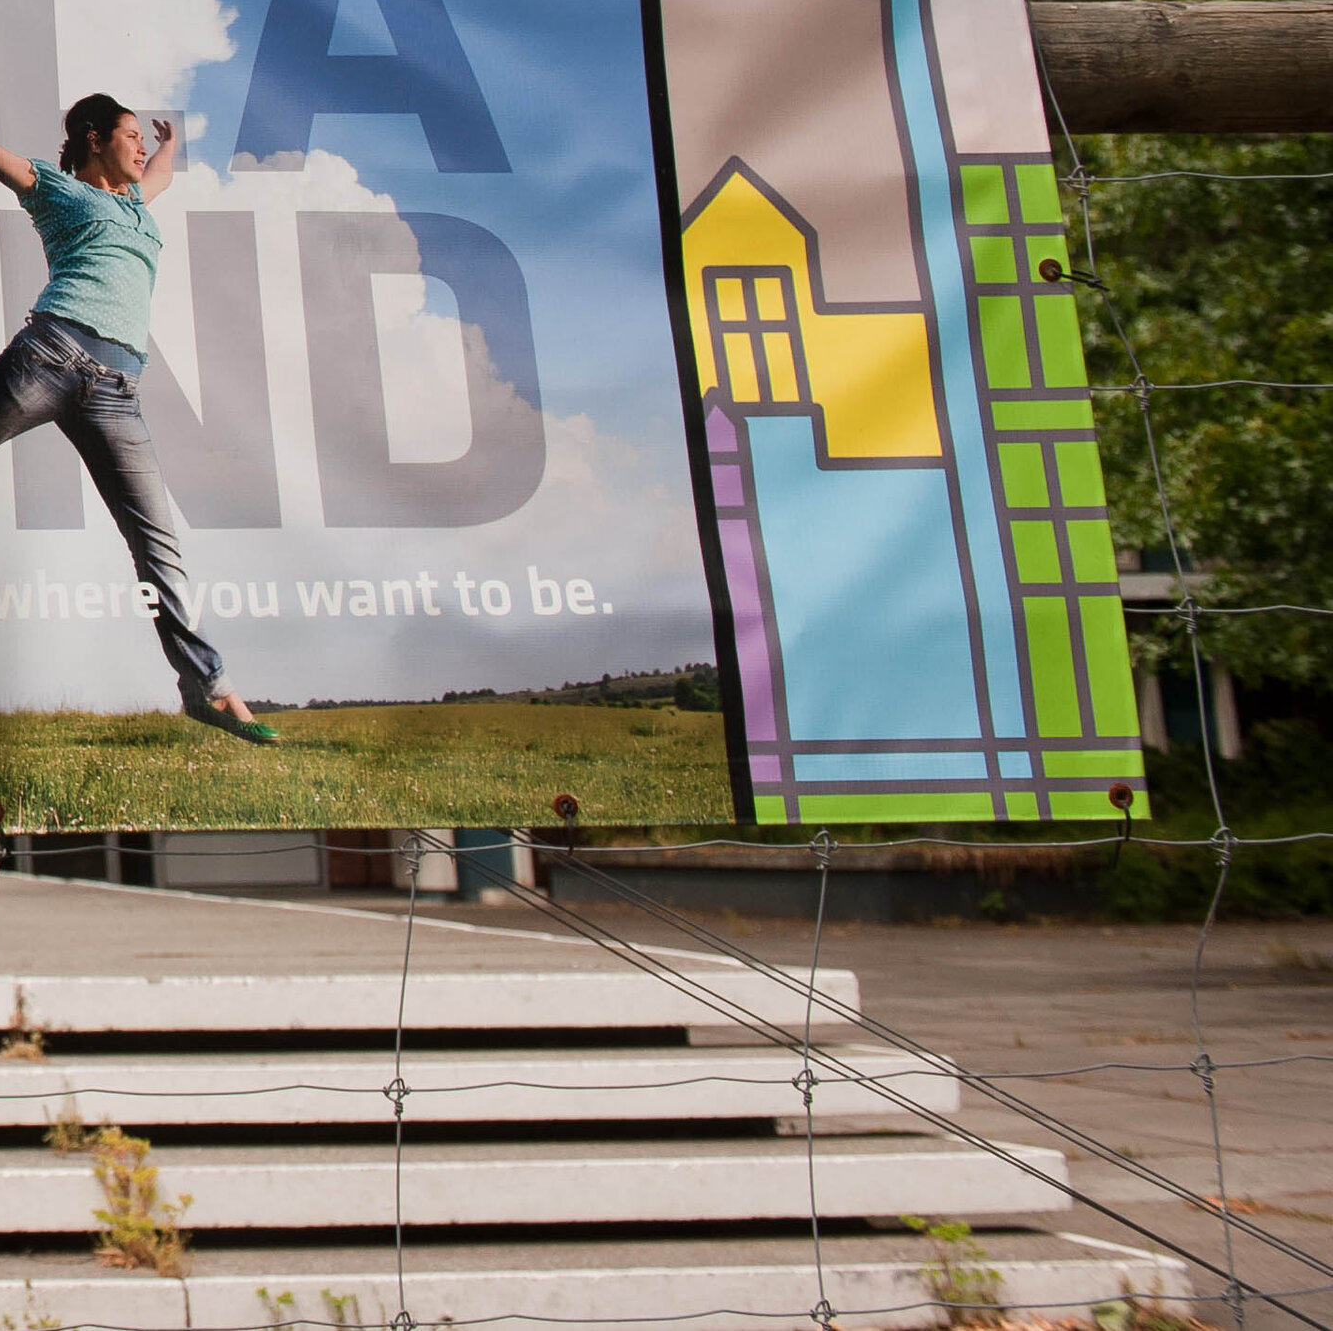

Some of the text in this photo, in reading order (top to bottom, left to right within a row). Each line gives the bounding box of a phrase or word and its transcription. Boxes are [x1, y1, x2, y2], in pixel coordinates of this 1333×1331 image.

[181, 576, 280, 632] you
[299, 571, 434, 617] want
[453, 572, 513, 616] to
[526, 565, 614, 615] be.
